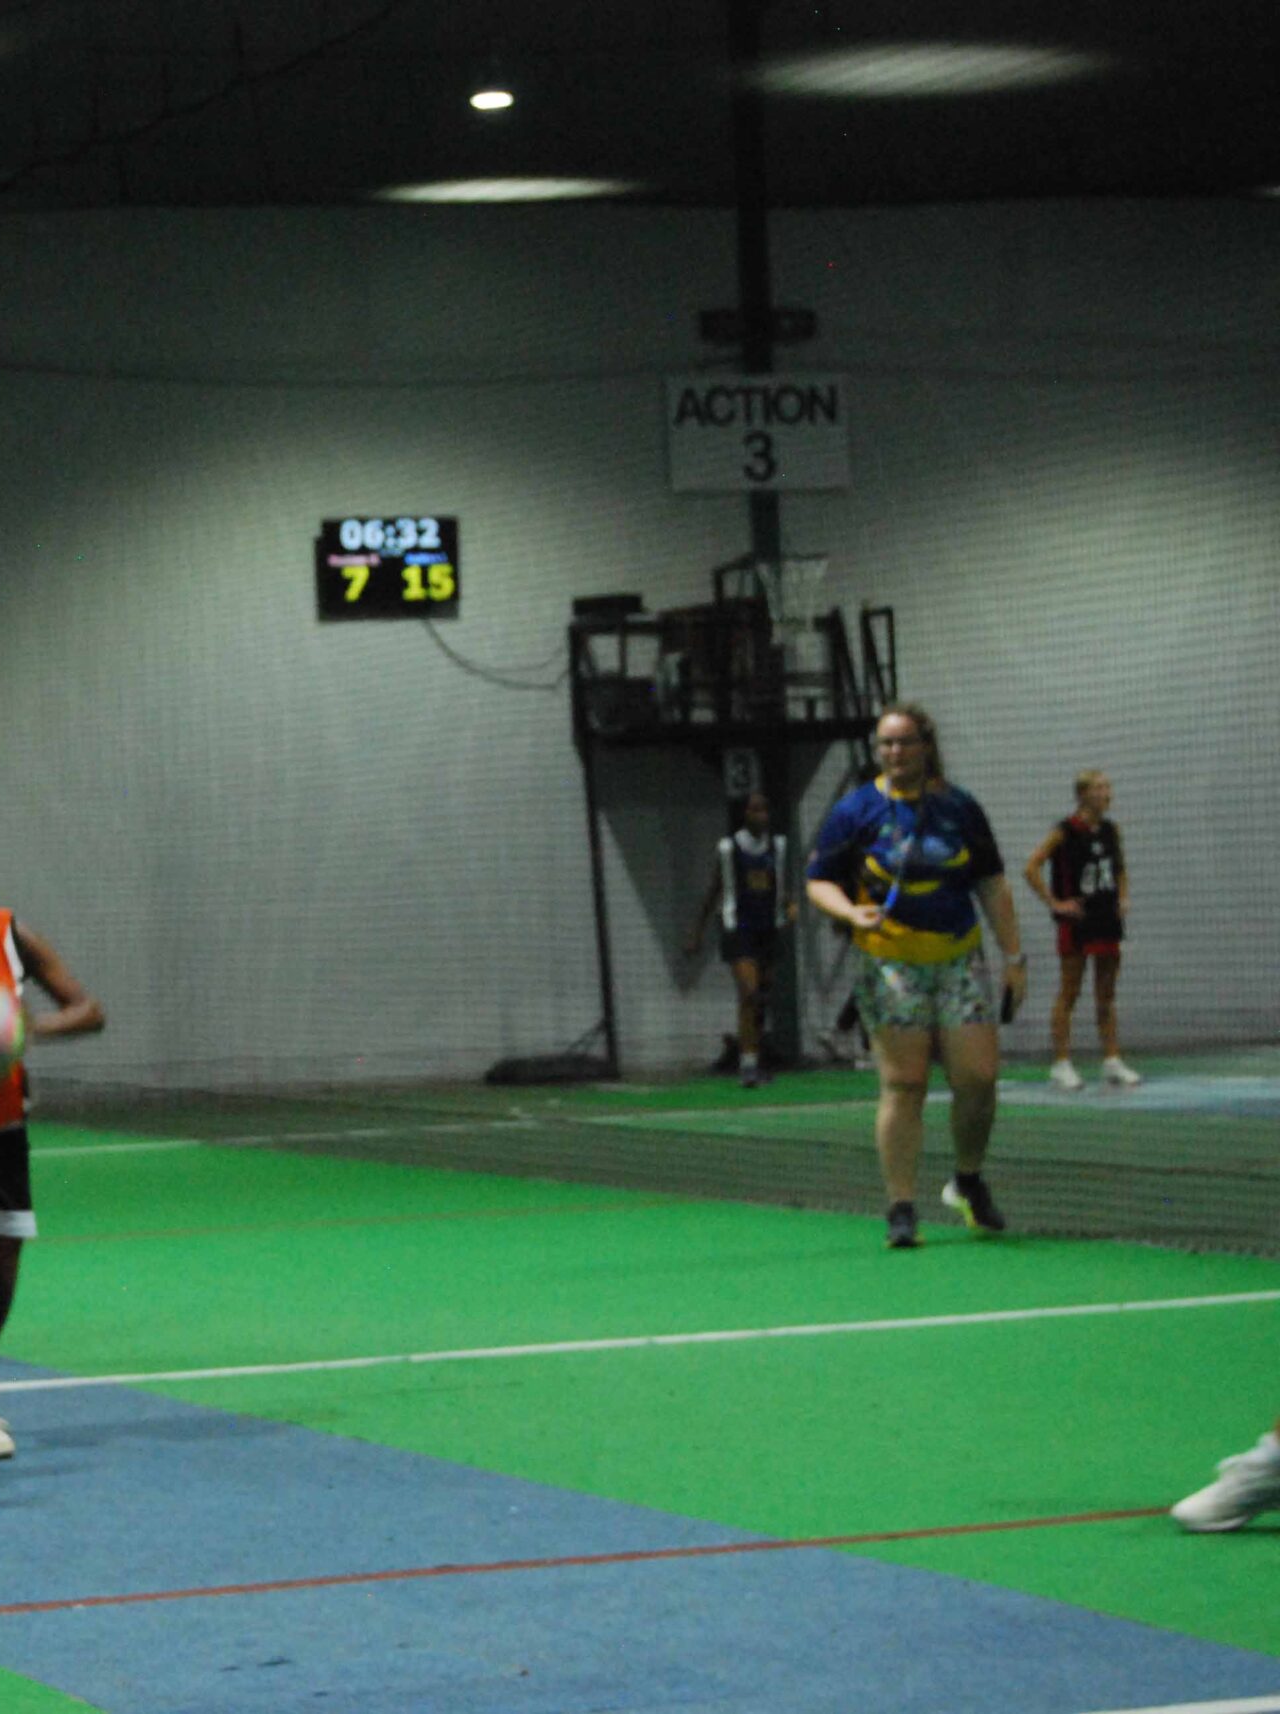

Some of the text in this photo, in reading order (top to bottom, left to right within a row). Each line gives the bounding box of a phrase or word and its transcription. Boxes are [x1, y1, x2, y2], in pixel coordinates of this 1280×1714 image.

[673, 384, 838, 426] ACTION
[744, 430, 777, 482] 3
[340, 518, 441, 550] 06:32
[341, 563, 455, 602] 7 15
